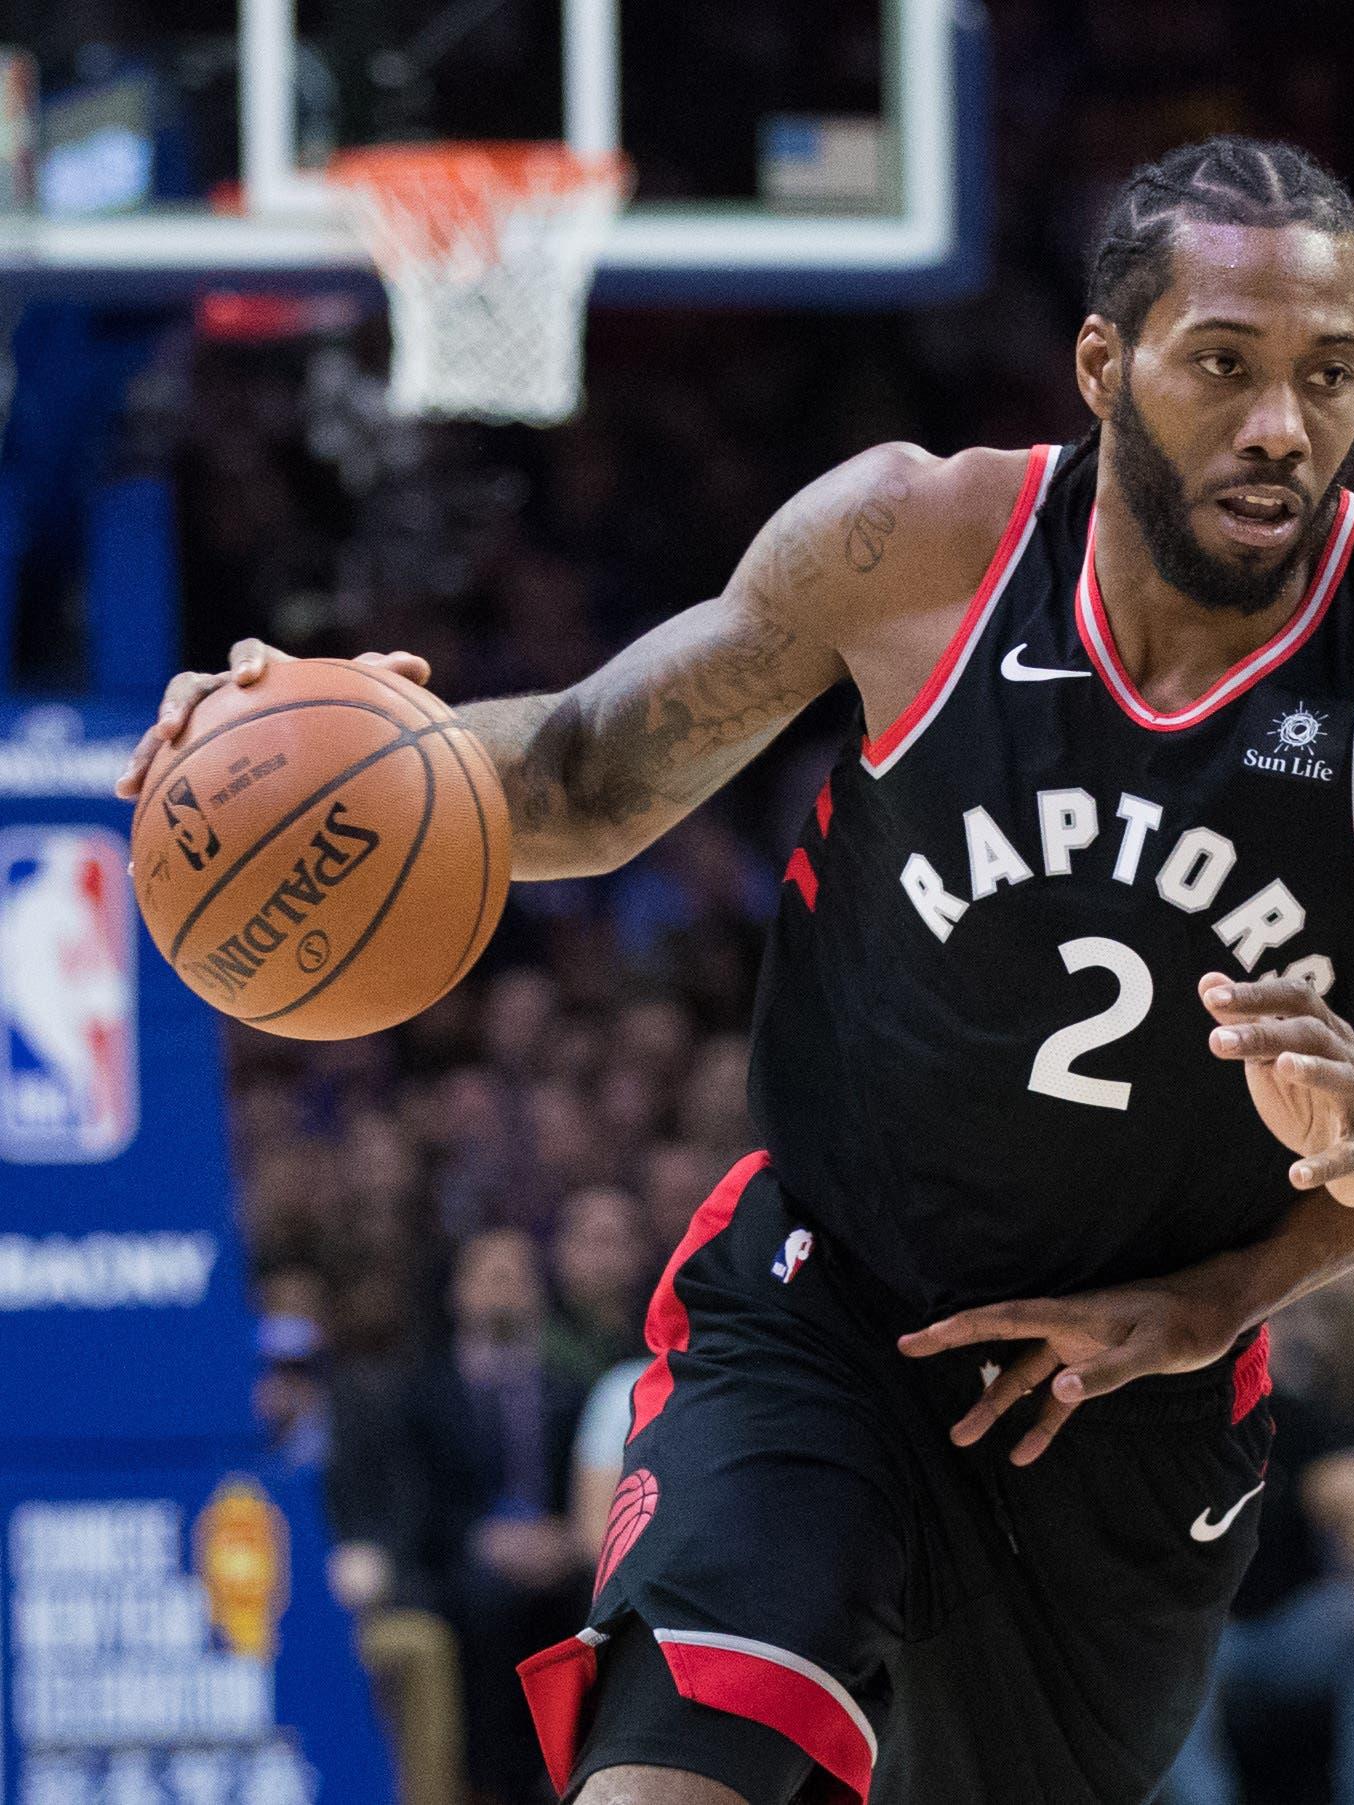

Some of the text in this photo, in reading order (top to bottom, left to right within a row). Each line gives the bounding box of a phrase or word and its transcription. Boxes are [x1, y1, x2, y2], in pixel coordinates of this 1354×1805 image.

[1243, 748, 1333, 781] Sun Life
[1028, 936, 1154, 1111] 2
